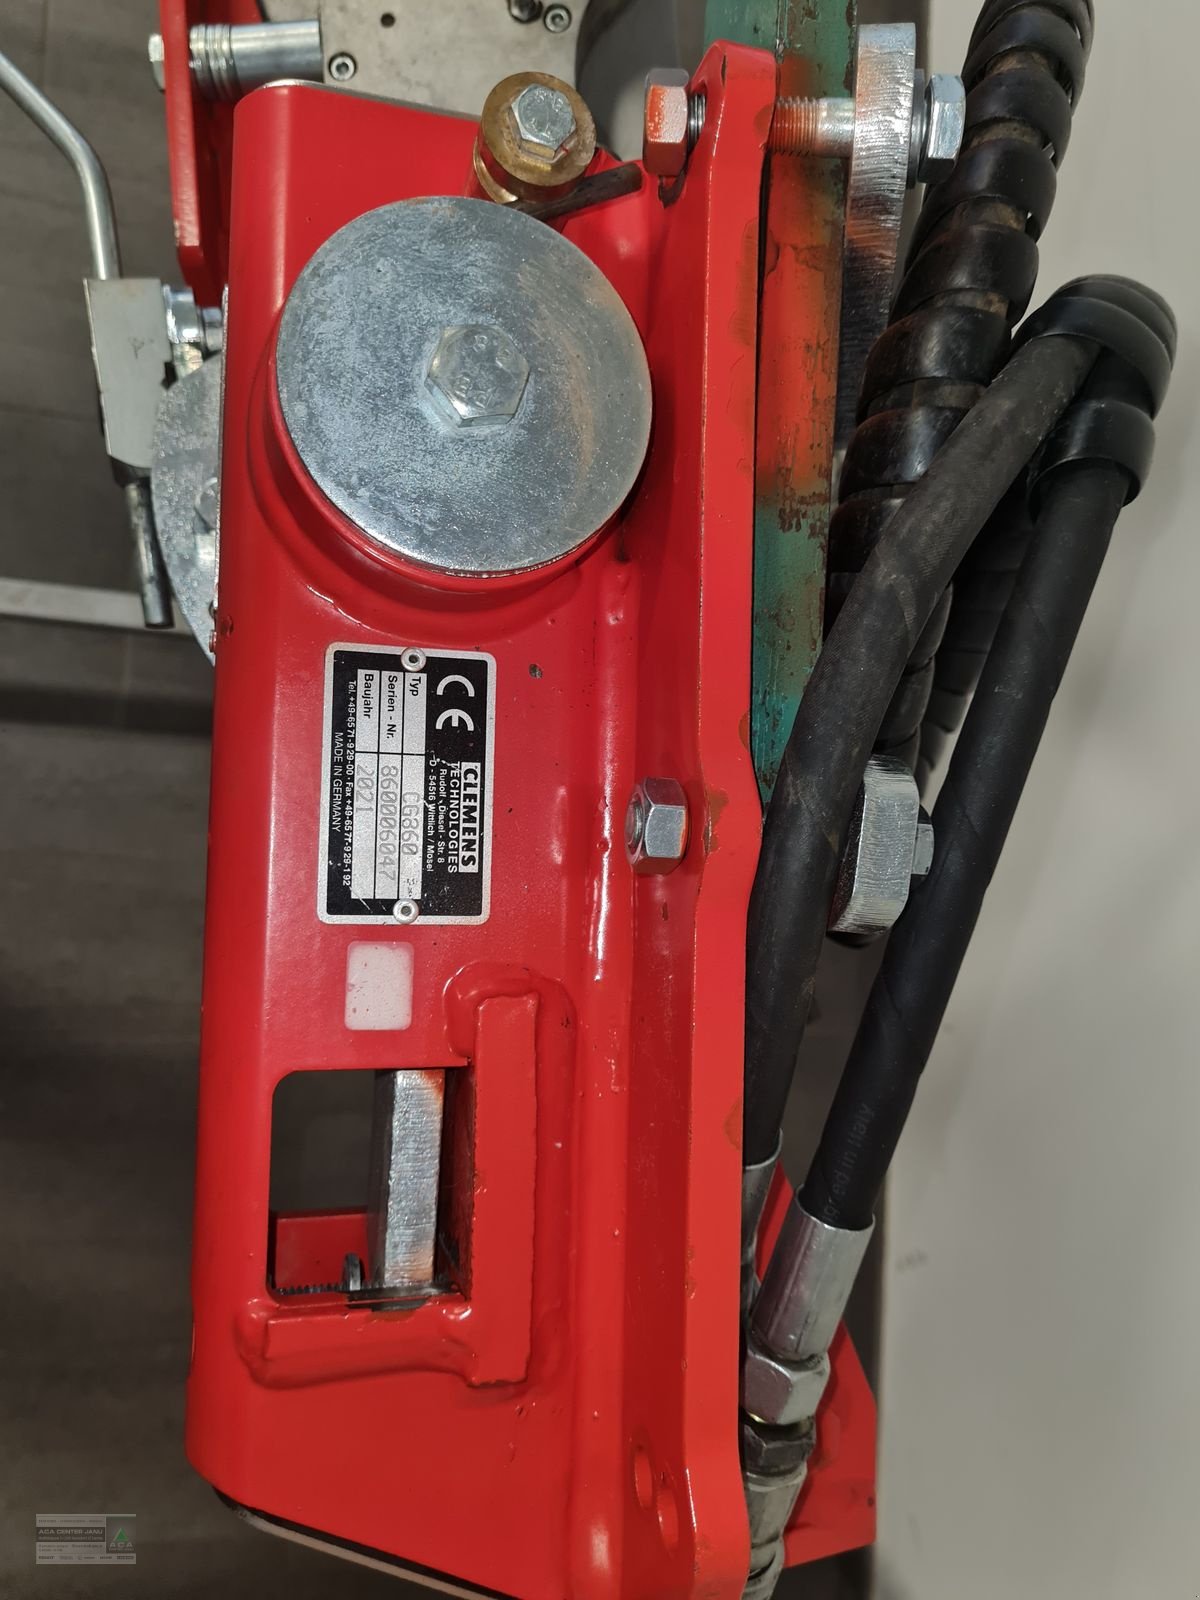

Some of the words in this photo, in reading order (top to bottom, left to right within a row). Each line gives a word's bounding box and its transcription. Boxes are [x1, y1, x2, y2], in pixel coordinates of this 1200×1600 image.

[348, 680, 357, 694] Tel.
[361, 673, 374, 719] Baujahr
[387, 675, 398, 712] Serien
[409, 676, 422, 697] Typ
[386, 723, 397, 739] Nr.
[333, 732, 344, 763] MADE
[333, 765, 343, 776] IN
[429, 759, 437, 767] D
[345, 782, 354, 797] Fax
[355, 764, 376, 813] 2021
[428, 775, 437, 801] 54516
[438, 768, 447, 797] Rudolf
[331, 778, 343, 833] GERMANY
[427, 803, 436, 836] Wittlich
[447, 760, 461, 873] TECHNOLOGIES
[461, 768, 478, 867] CLEMENS
[378, 765, 399, 881] 860006047
[401, 792, 421, 856] CG860
[426, 845, 435, 872] Mosel
[437, 841, 446, 855] Str.
